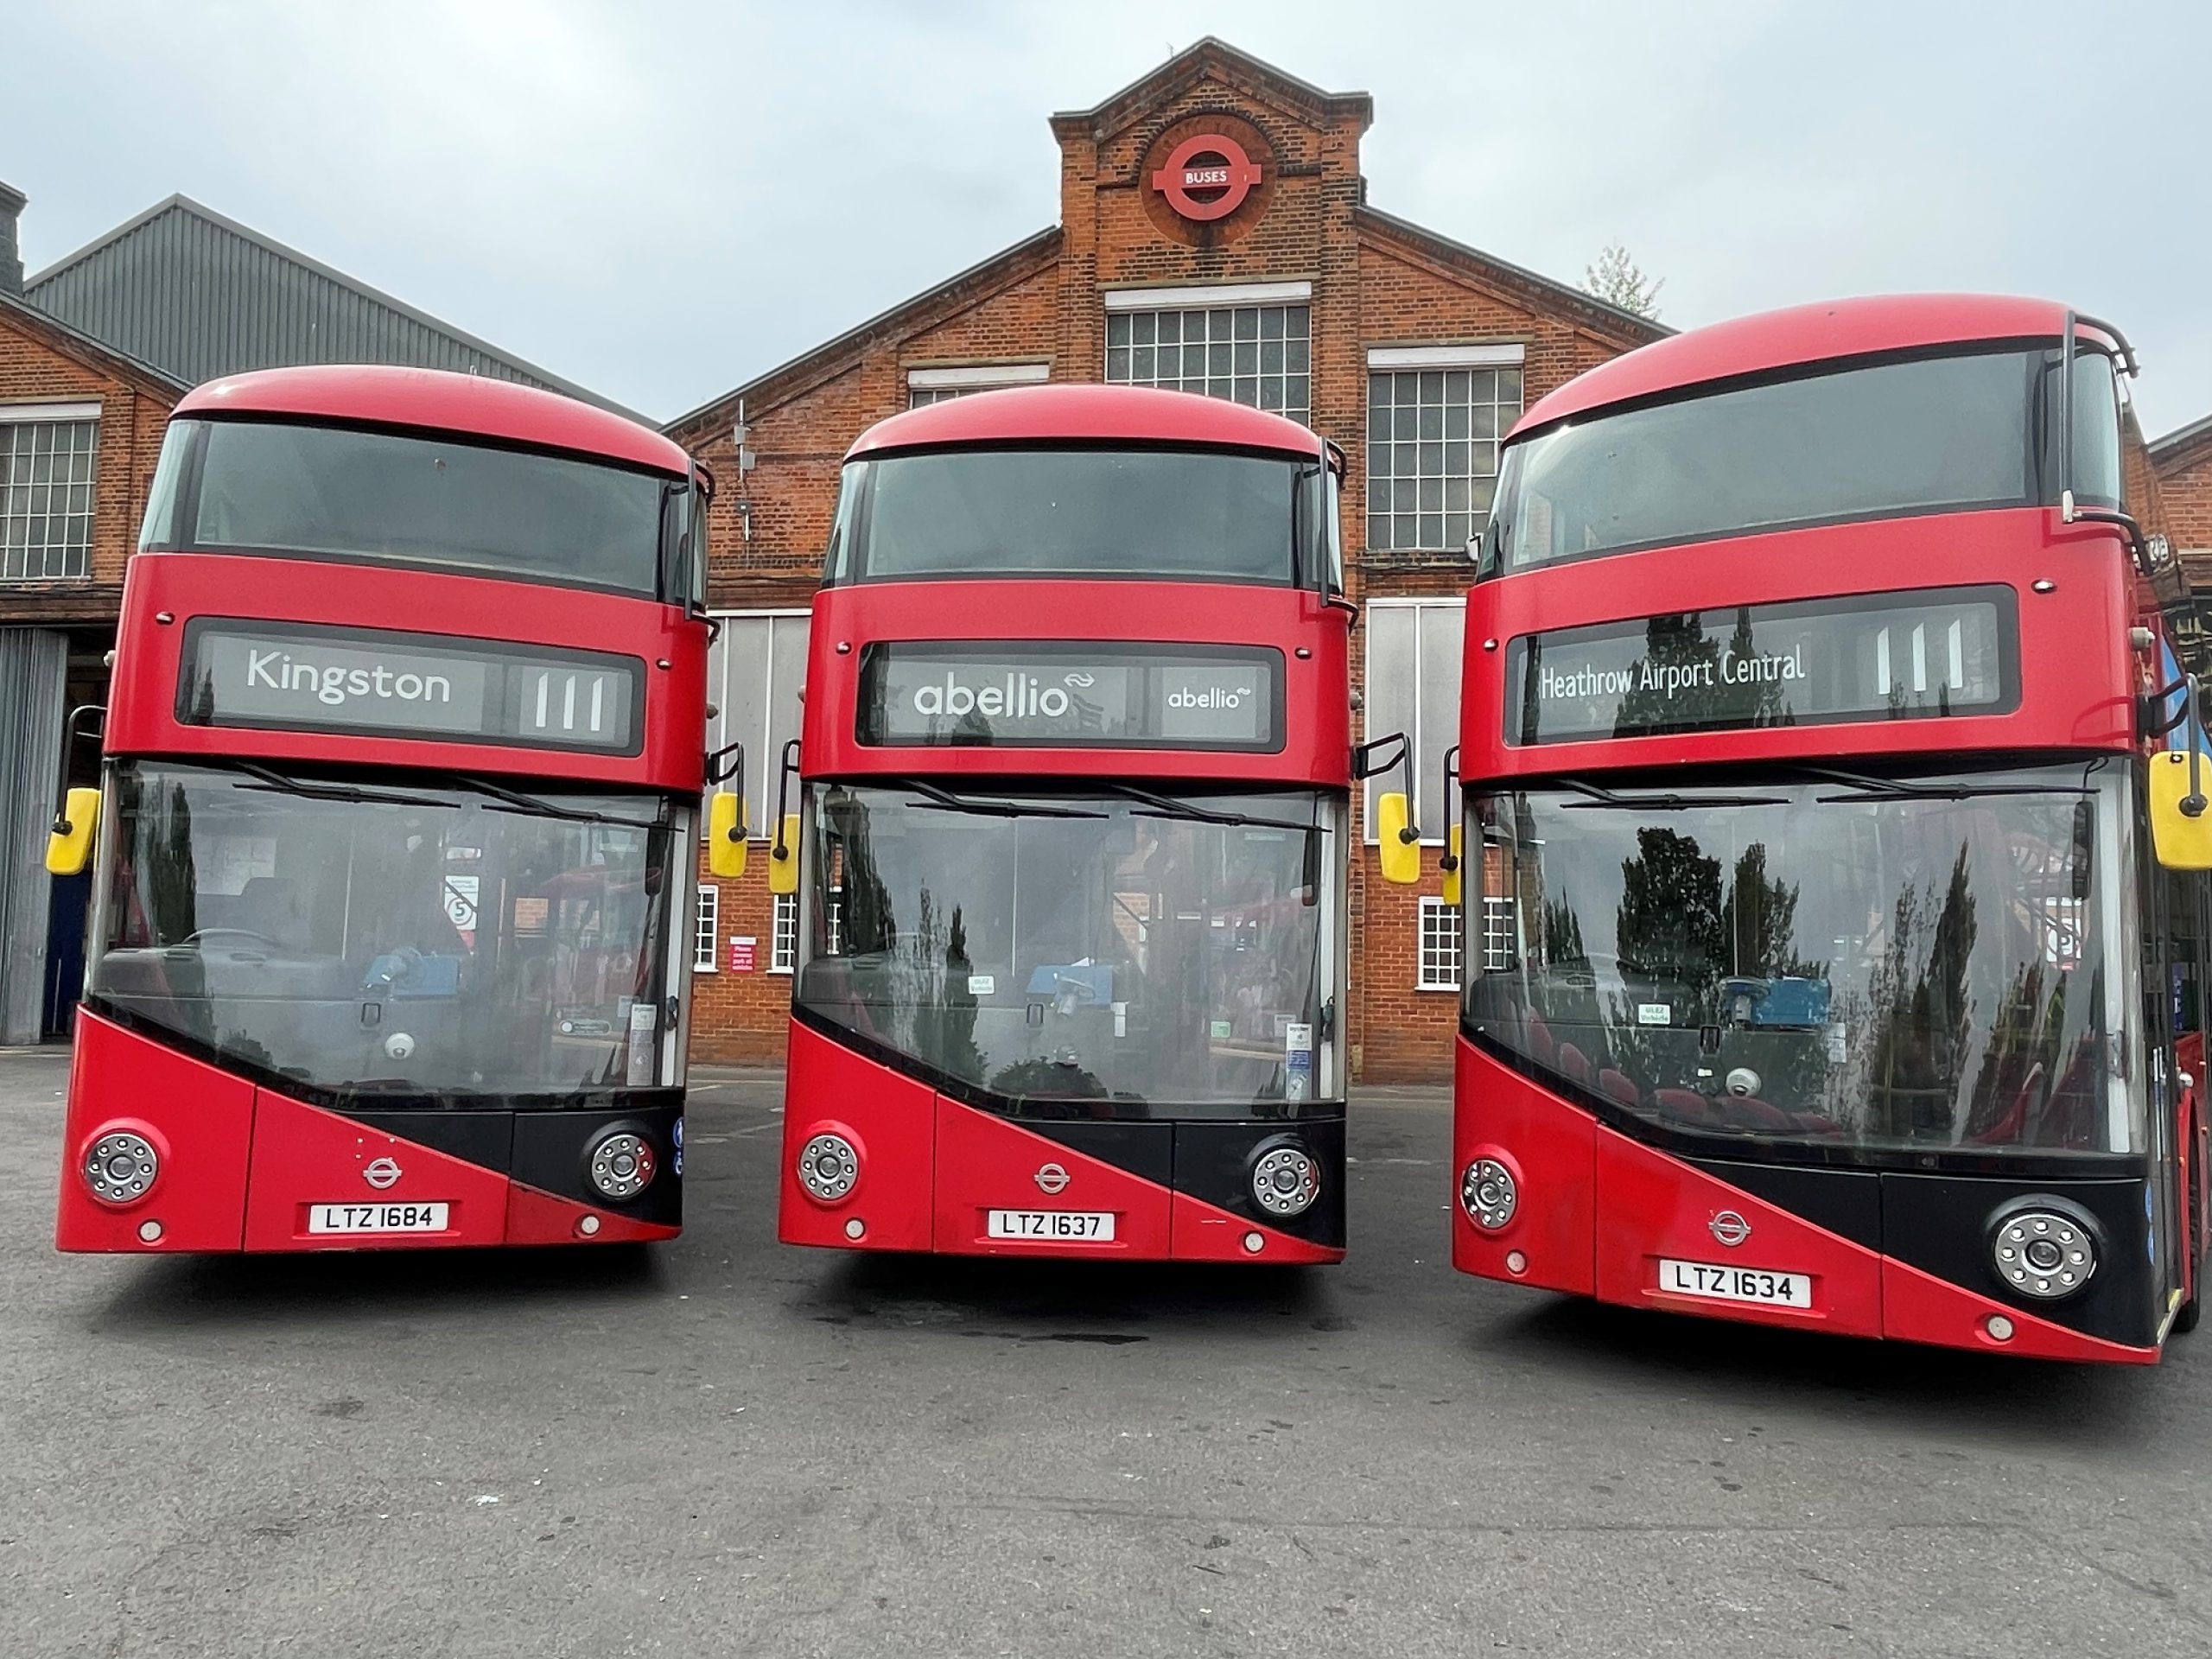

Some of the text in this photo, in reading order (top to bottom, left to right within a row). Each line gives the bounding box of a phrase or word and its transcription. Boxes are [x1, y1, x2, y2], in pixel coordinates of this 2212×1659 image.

[1185, 170, 1227, 184] BUSES
[246, 649, 450, 705] Kingston
[1541, 644, 1806, 700] Heathrow Airport Central
[1877, 619, 1964, 696] 111
[535, 671, 605, 732] 111
[913, 671, 1070, 718] abellio
[1167, 686, 1240, 709] abellio
[326, 1206, 433, 1228] LTZ 1684
[1002, 1213, 1101, 1236] LTZ 1637
[1675, 1265, 1793, 1300] LTZ 1634
